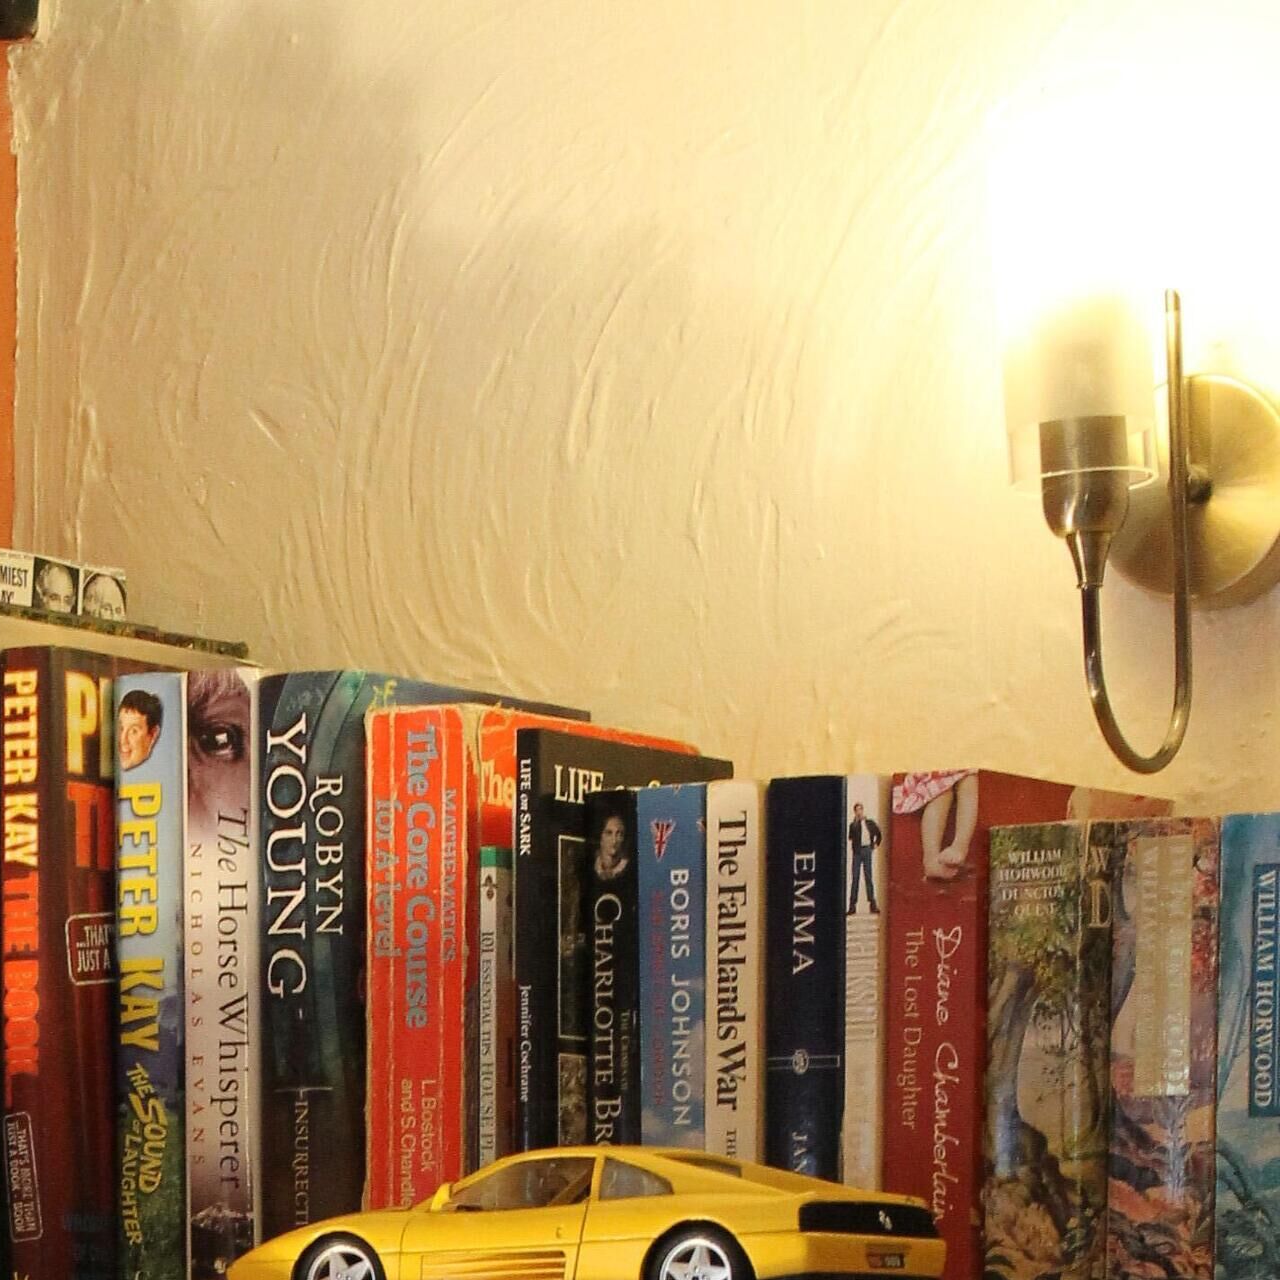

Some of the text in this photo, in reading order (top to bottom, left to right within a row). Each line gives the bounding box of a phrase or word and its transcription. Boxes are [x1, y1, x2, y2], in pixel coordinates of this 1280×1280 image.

[4, 669, 38, 866] PETER KAY
[266, 712, 308, 999] YOUNG
[309, 775, 344, 937] ROBYN
[520, 758, 531, 857] LIFE SARK
[77, 951, 101, 973] JUST
[118, 783, 164, 1052] PETER KAY
[405, 724, 440, 1030] The Core Course
[716, 810, 747, 1111] The Falklands War
[792, 851, 816, 975] EMMA
[4, 871, 39, 1077] THE BOOK
[190, 844, 205, 1166] NICHOLAS EVANS
[210, 807, 250, 1189] The Horse Whisperer
[519, 984, 532, 1102] Jennifer Cochrane
[594, 893, 622, 1084] CHARLOTTE
[670, 868, 691, 1126] BORIS JOHNSON
[897, 926, 925, 1131] The Lost Daughter
[932, 925, 963, 1026] Diane
[1254, 870, 1277, 1108] WILLIAM HORWOOD
[126, 1063, 156, 1101] THE
[128, 1092, 169, 1194] SOUND
[401, 1079, 414, 1117] and
[422, 1097, 437, 1172] Bostock
[121, 1125, 143, 1247] LAUGHTER
